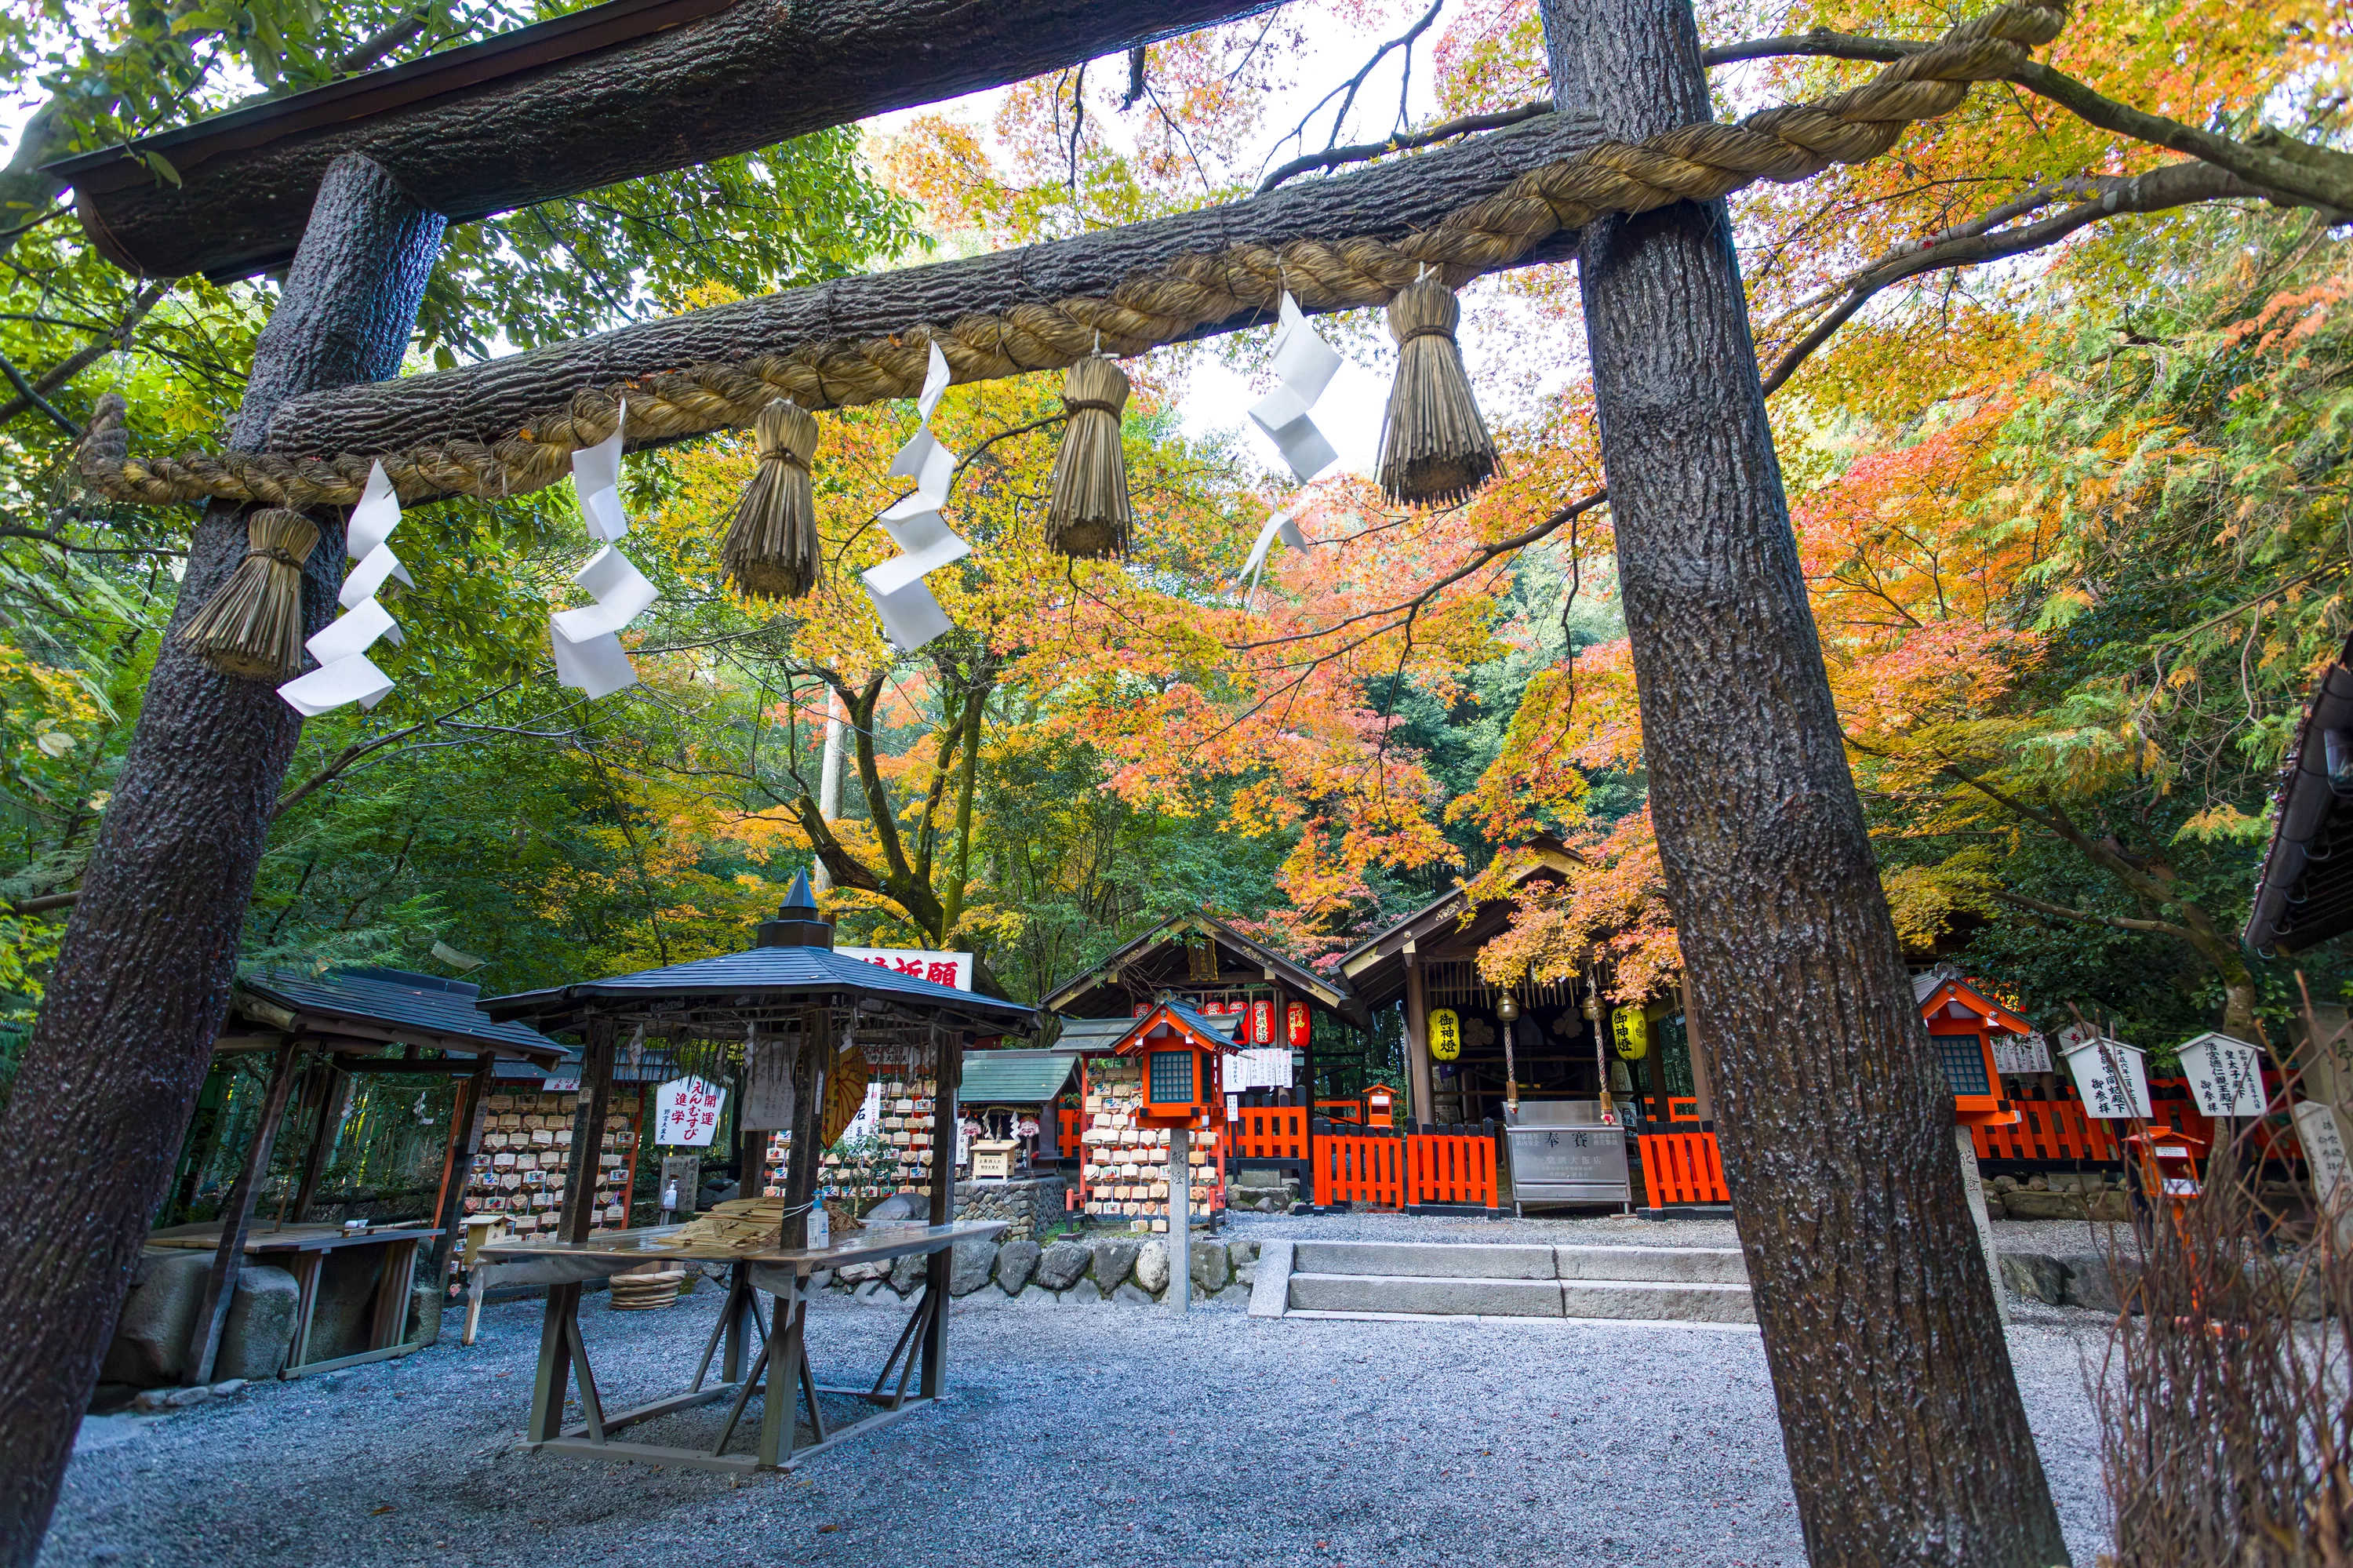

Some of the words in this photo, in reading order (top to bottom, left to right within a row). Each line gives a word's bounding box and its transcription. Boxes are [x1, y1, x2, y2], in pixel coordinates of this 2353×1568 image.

[1296, 1009, 1305, 1028] オール
[671, 1092, 688, 1125] 進学
[684, 1081, 704, 1141] えんむすび
[700, 1094, 717, 1126] 開運
